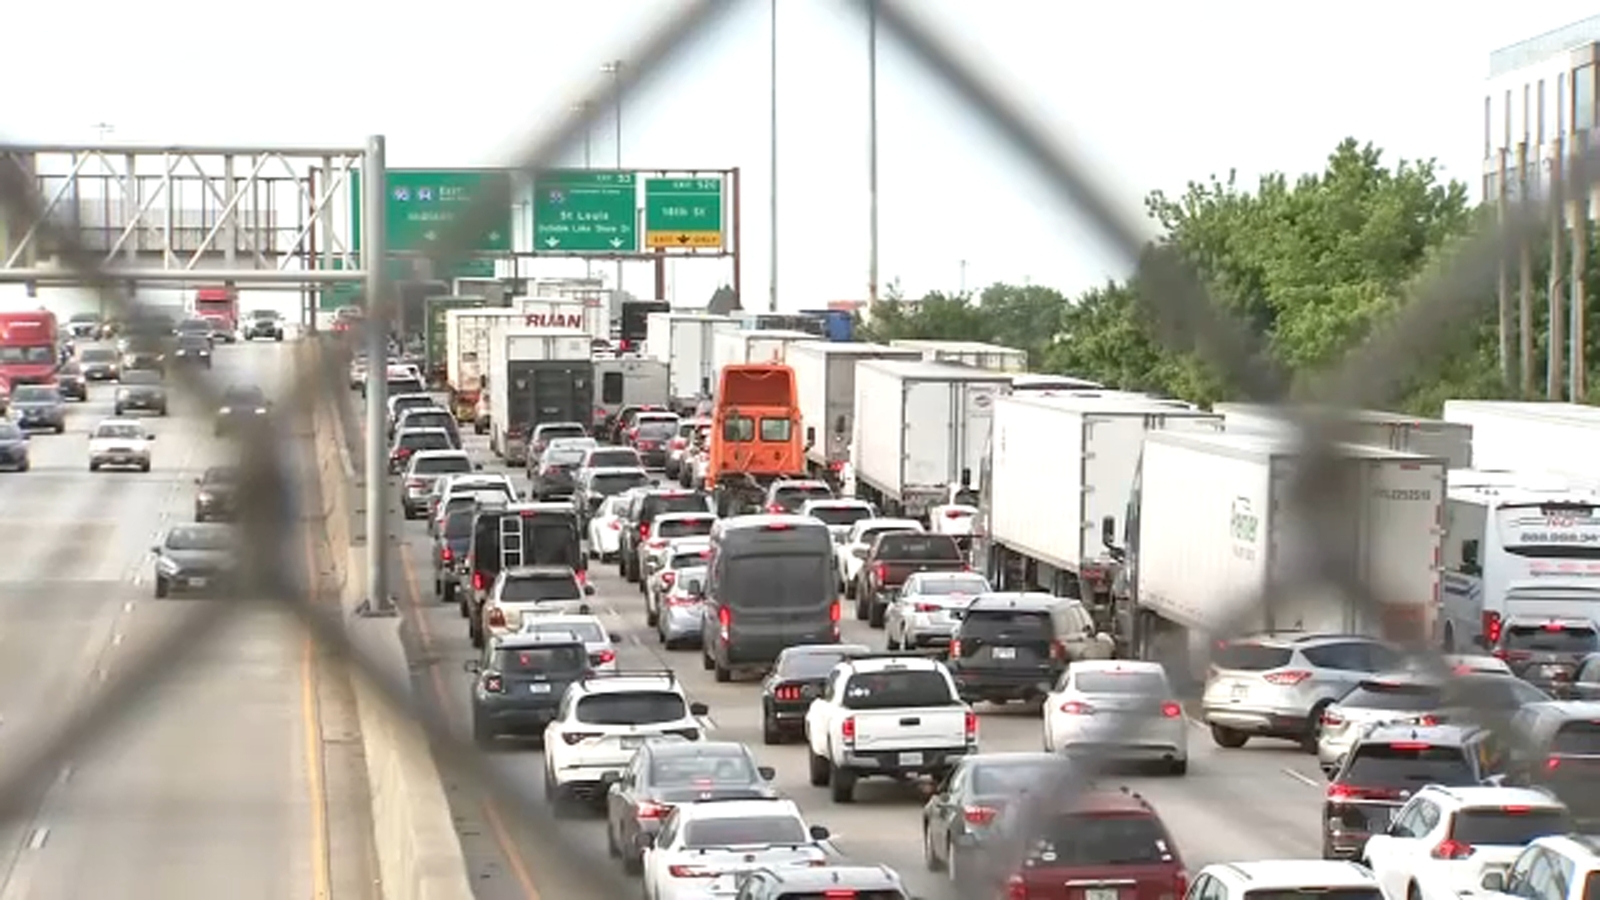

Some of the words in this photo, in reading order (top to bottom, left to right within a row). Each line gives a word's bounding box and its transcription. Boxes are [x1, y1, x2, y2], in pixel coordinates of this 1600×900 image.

[560, 211, 573, 221] St
[577, 210, 609, 221] Louis
[661, 206, 688, 216] 18th
[693, 206, 707, 217] St
[525, 313, 582, 329] RUAN
